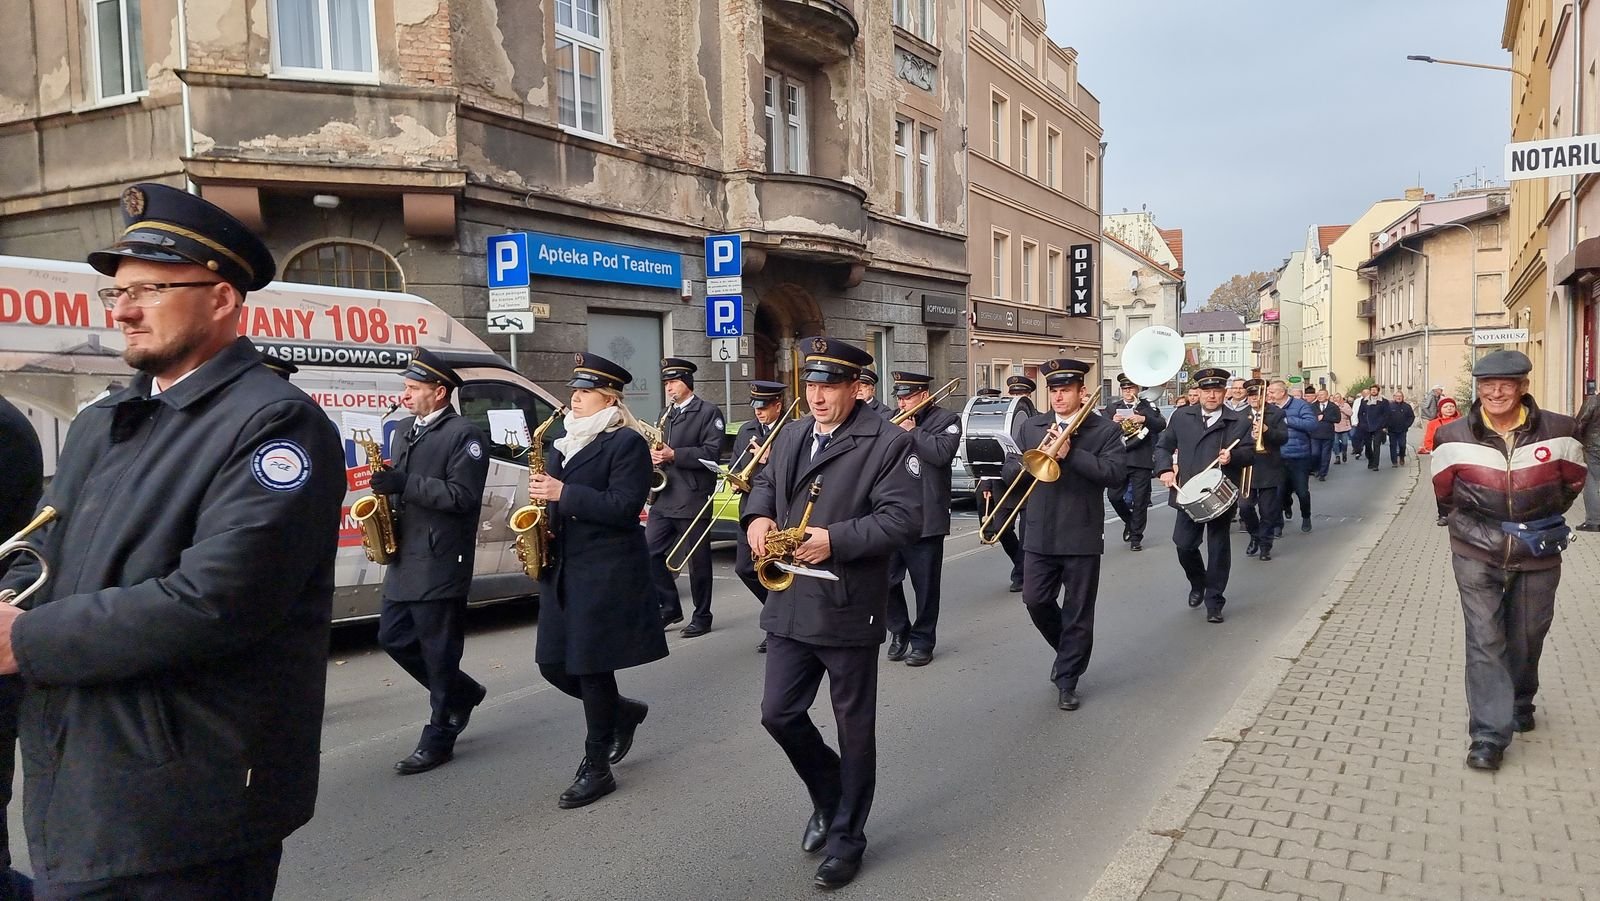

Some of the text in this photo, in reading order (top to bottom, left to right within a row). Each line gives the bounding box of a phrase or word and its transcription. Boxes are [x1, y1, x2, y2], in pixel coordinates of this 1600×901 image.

[1512, 143, 1600, 172] NOTARIU
[495, 240, 519, 282] P
[538, 244, 672, 275] Apteka Pod Teatrem
[713, 240, 733, 272] P
[1074, 248, 1087, 314] OPTYK
[0, 287, 90, 328] DOM
[325, 305, 390, 344] 108
[714, 300, 734, 332] P
[1477, 333, 1527, 341] NOTARIUSZ
